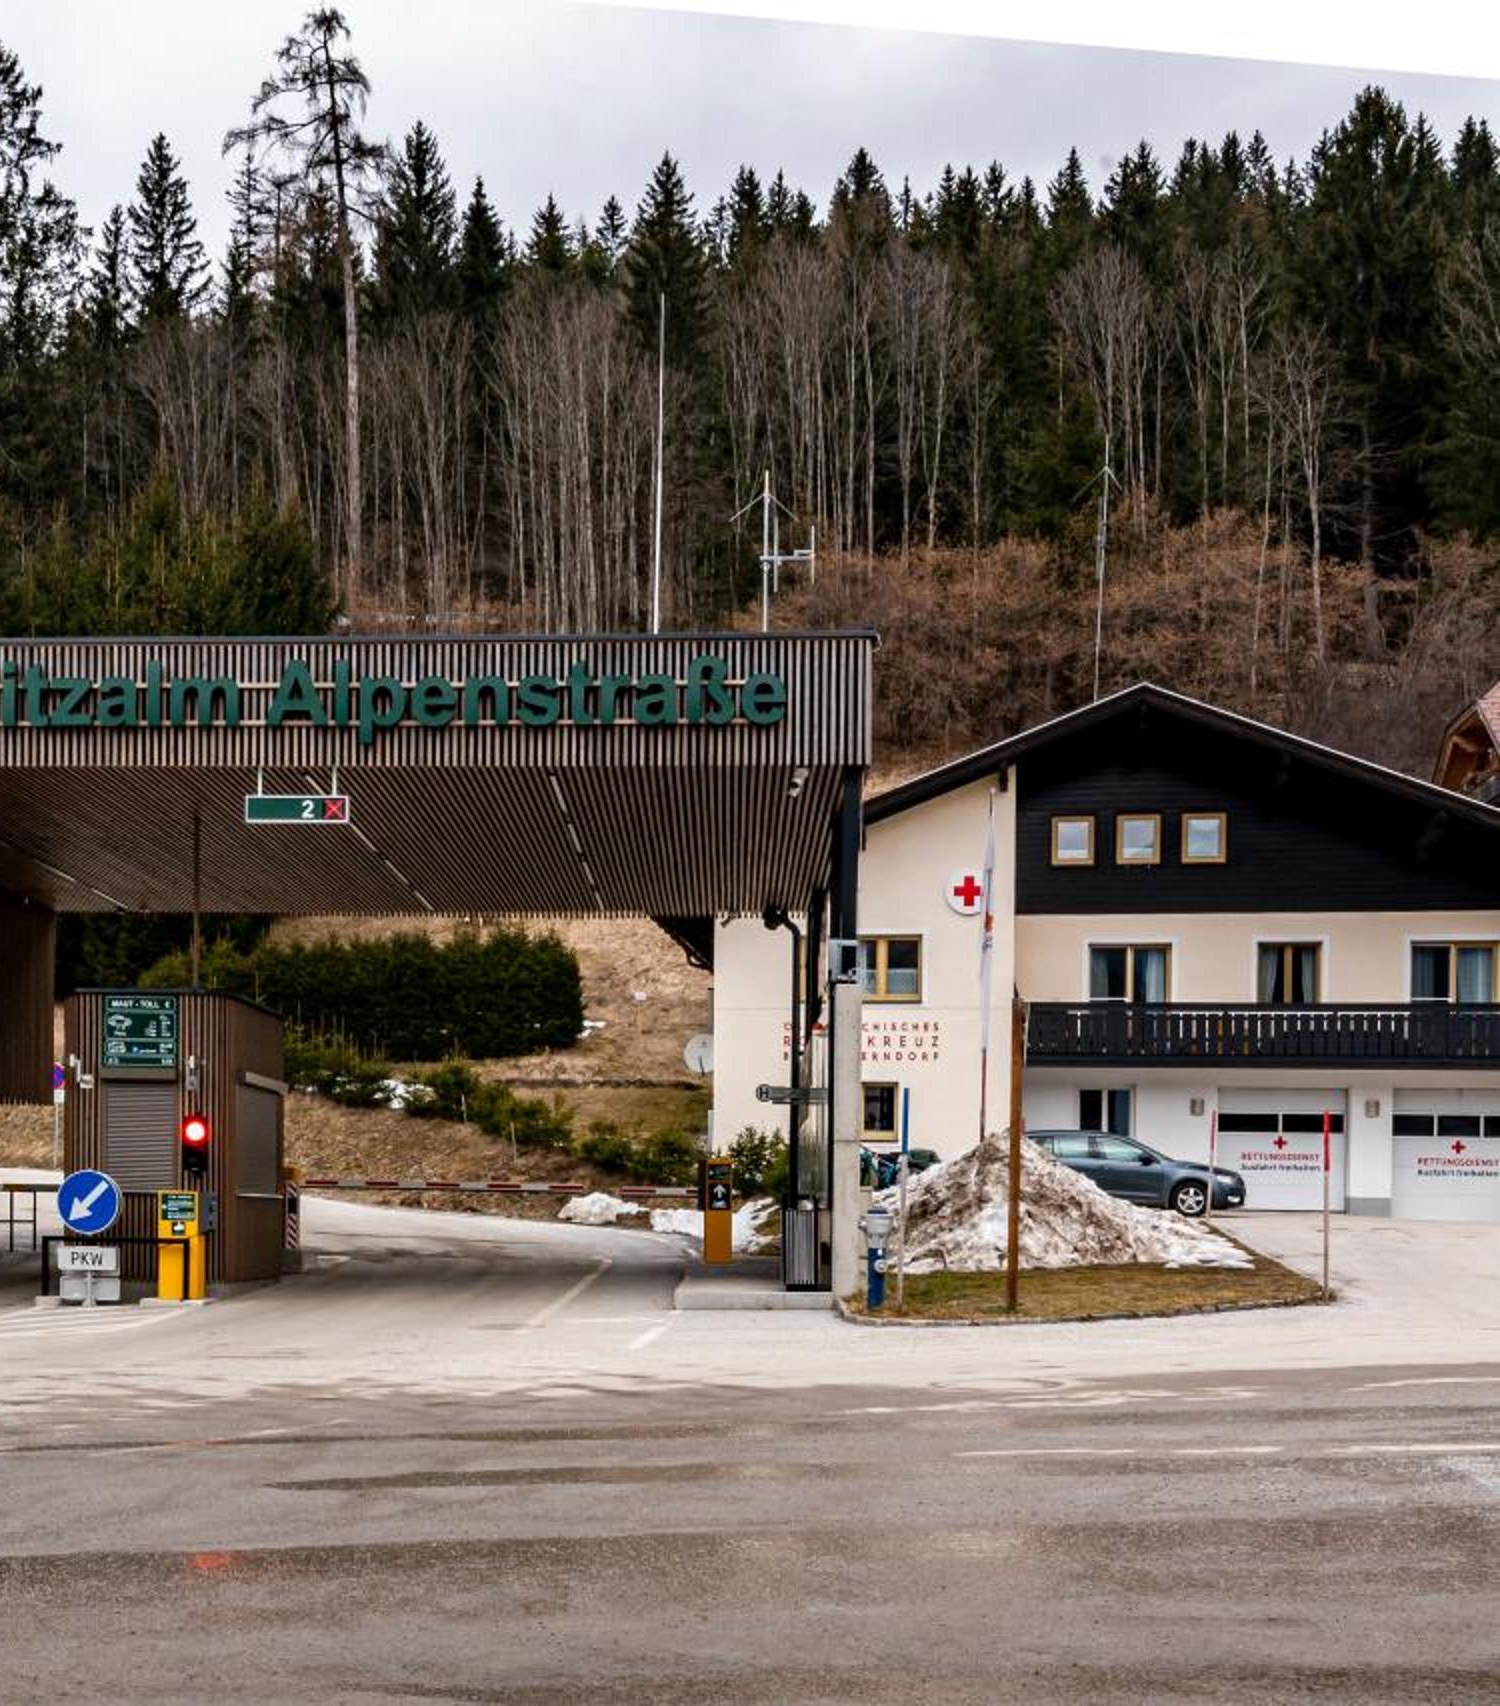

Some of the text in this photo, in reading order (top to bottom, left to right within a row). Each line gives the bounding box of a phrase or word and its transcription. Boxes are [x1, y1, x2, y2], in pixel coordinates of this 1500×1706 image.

[266, 656, 788, 747] Alpenstraße
[301, 799, 316, 819] 2
[867, 1035, 939, 1047] KREUZ
[1240, 1152, 1319, 1161] RETTUNGSDIENST
[1417, 1157, 1499, 1167] RETTUNGSDIENST
[71, 1251, 103, 1265] PKW
